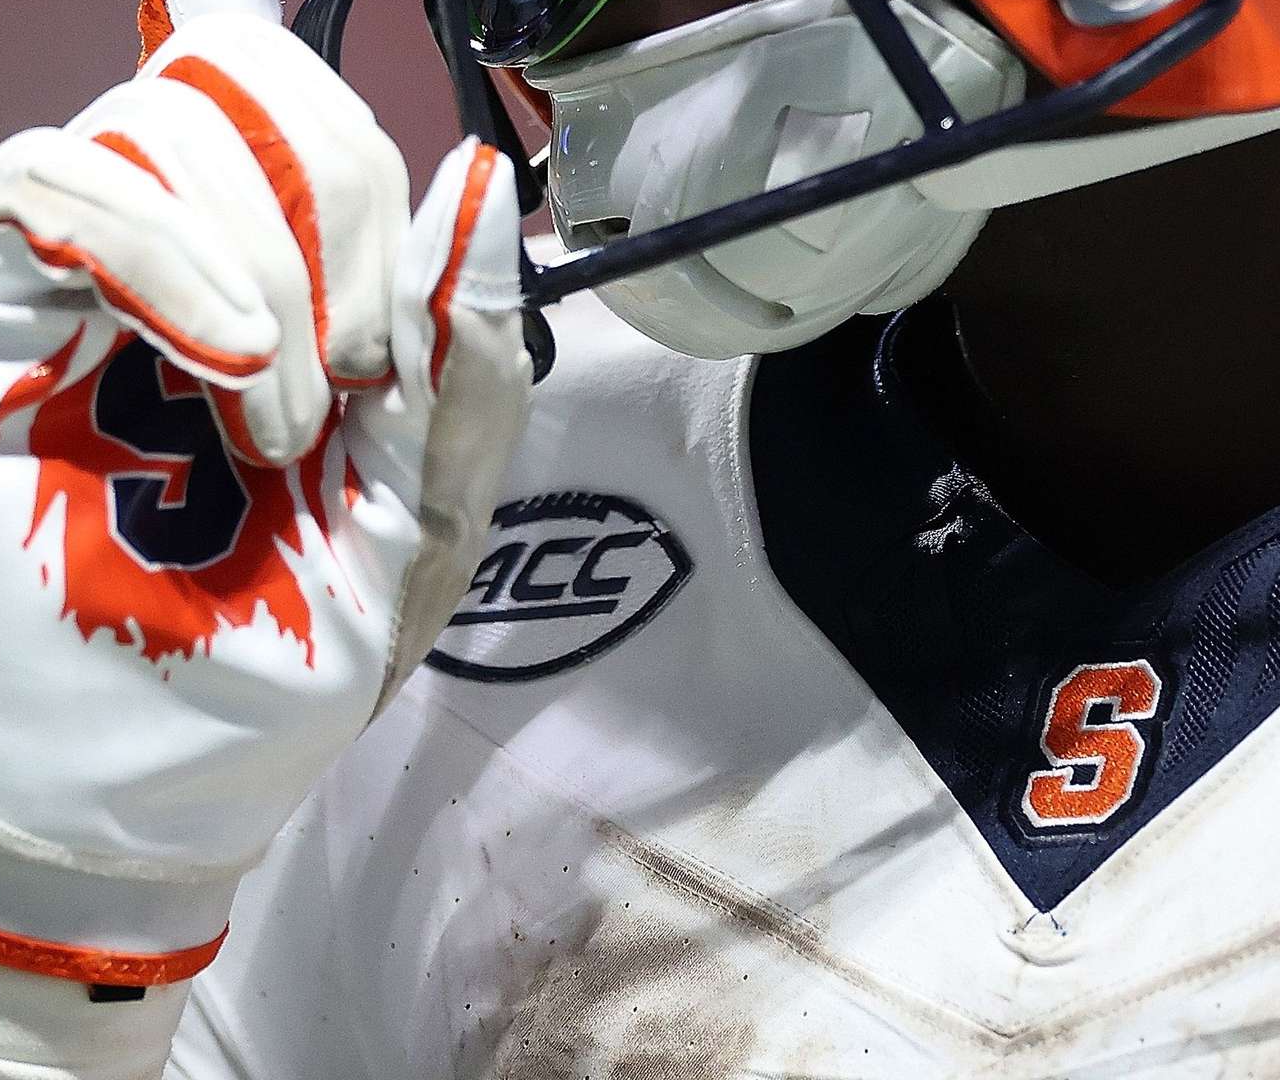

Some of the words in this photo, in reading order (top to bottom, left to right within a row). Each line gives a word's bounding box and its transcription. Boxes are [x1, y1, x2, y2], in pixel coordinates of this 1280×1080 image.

[91, 334, 253, 573] S
[467, 529, 654, 604] ACC
[1021, 659, 1162, 828] S
